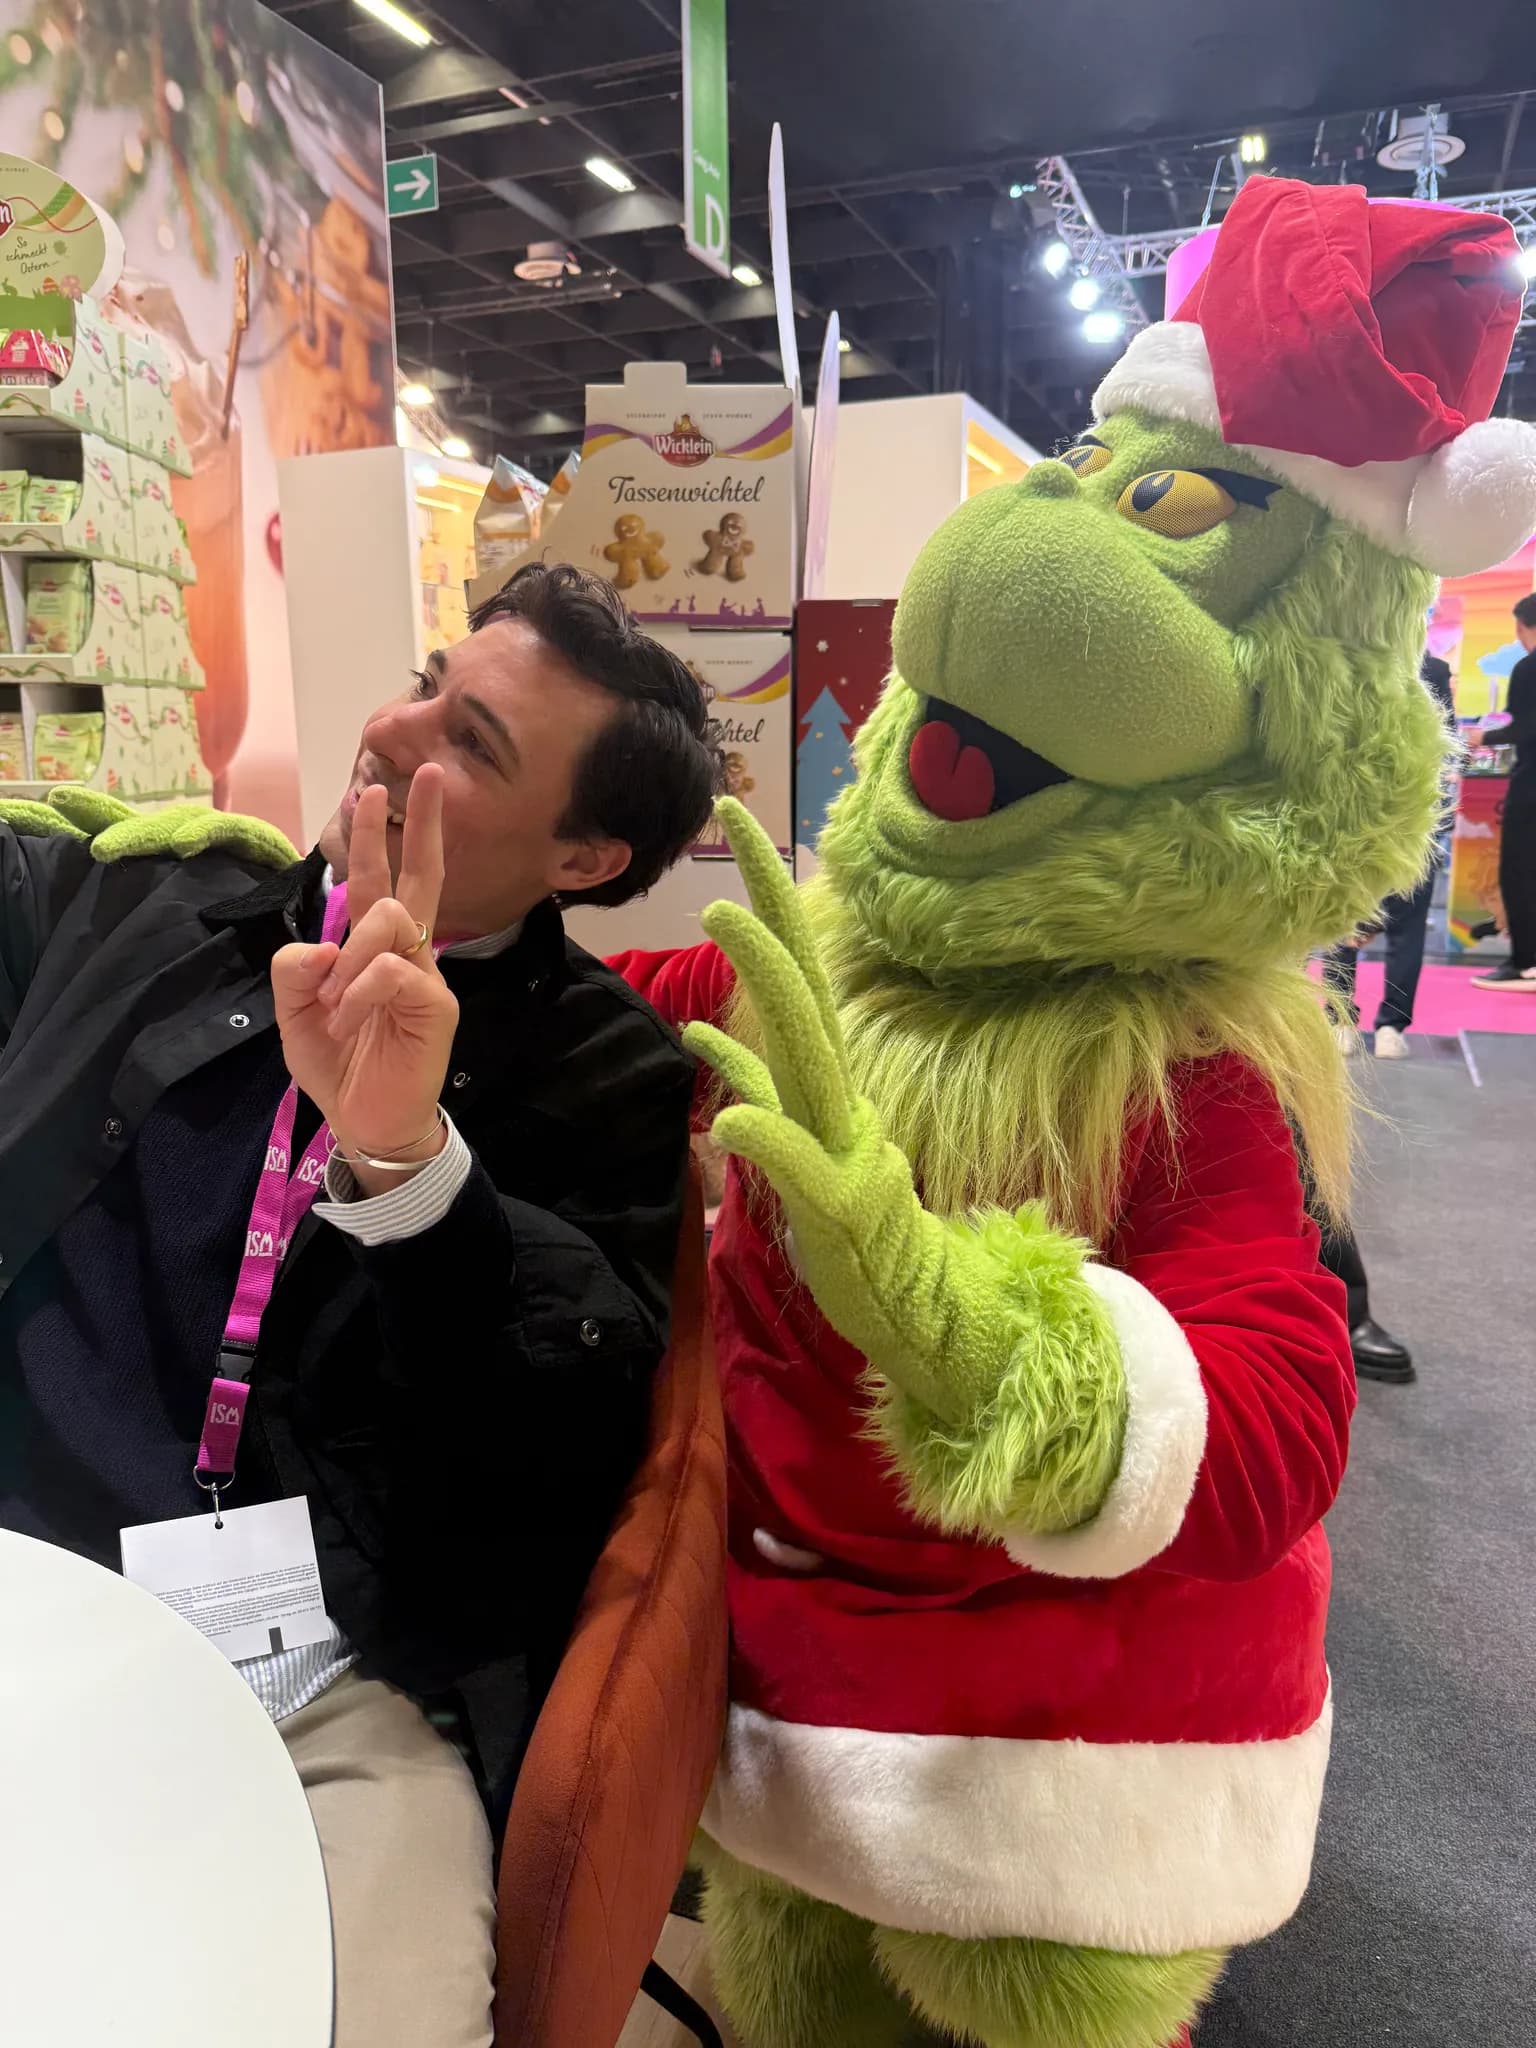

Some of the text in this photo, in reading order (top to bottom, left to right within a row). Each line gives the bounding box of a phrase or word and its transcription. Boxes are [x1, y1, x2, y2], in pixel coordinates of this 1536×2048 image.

[705, 193, 727, 260] D
[6, 242, 48, 262] schmeckt
[16, 236, 28, 249] So
[655, 435, 714, 455] Wicklein
[608, 475, 765, 505] Tassenwichtel
